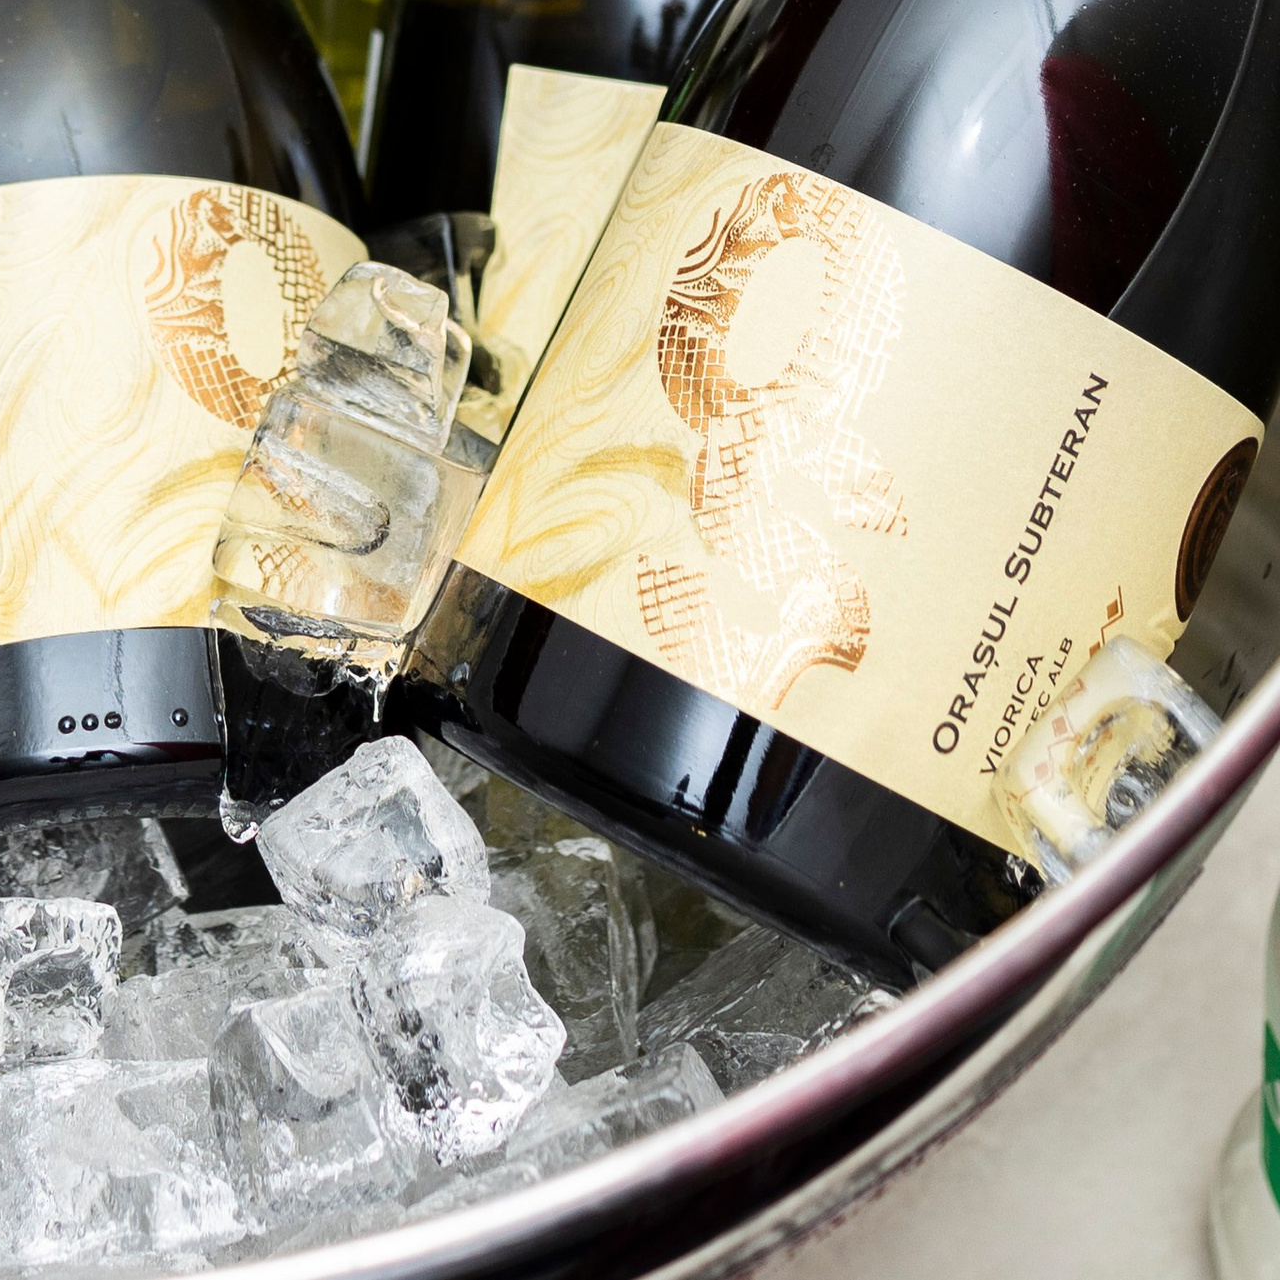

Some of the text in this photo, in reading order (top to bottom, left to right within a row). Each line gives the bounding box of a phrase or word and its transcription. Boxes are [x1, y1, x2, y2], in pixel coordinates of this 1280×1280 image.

[1003, 372, 1109, 586] SUBTERAN
[980, 654, 1045, 775] VIORICA
[1048, 637, 1073, 687] ALB
